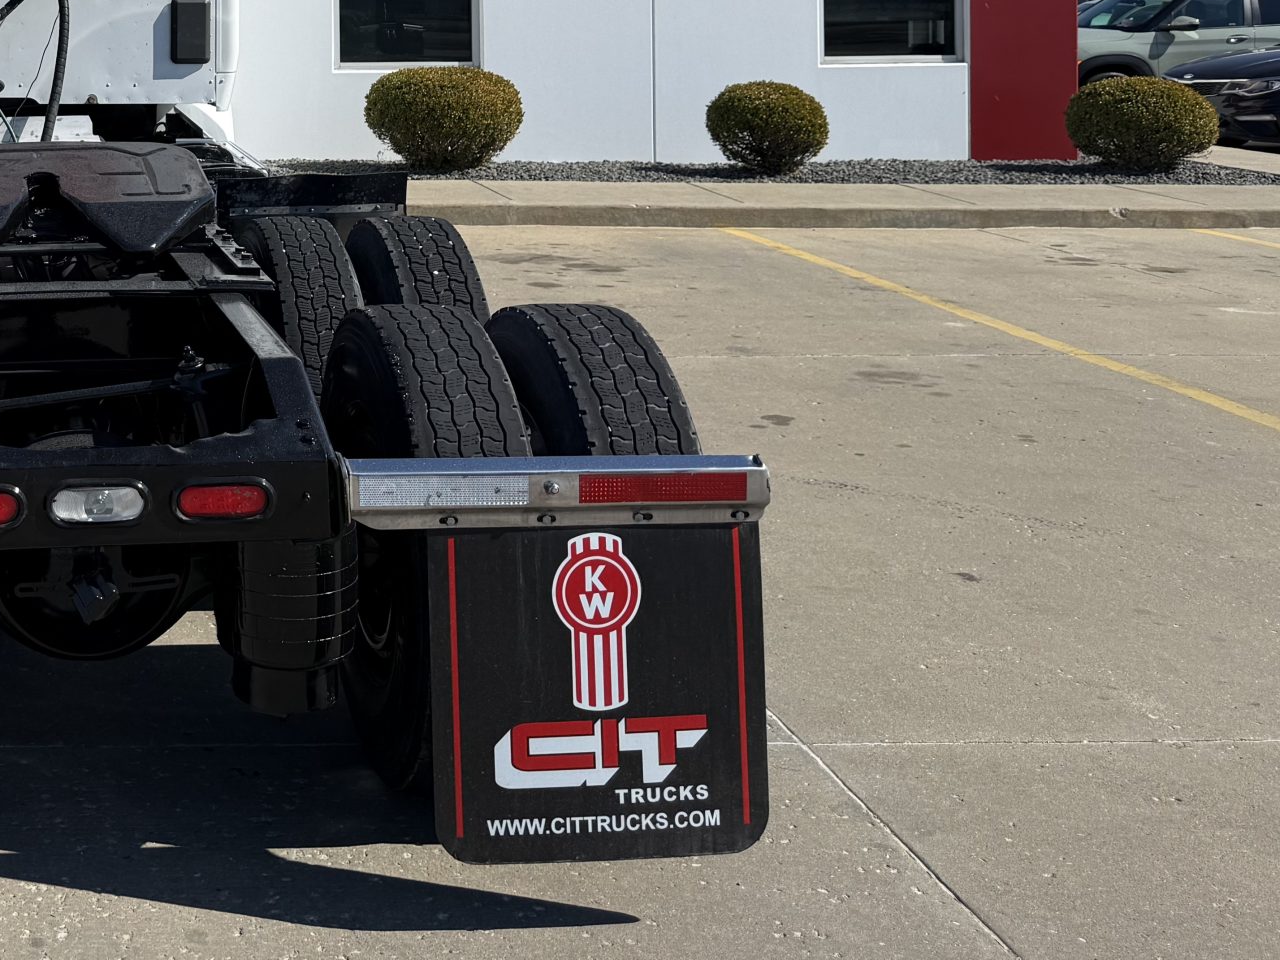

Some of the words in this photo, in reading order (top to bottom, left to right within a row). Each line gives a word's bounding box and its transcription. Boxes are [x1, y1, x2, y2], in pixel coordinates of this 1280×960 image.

[584, 564, 607, 592] K
[579, 592, 614, 619] W
[493, 714, 709, 789] CIT
[615, 784, 709, 805] TRUCKS
[486, 808, 721, 837] WWW.CITTRUCKS.COM
